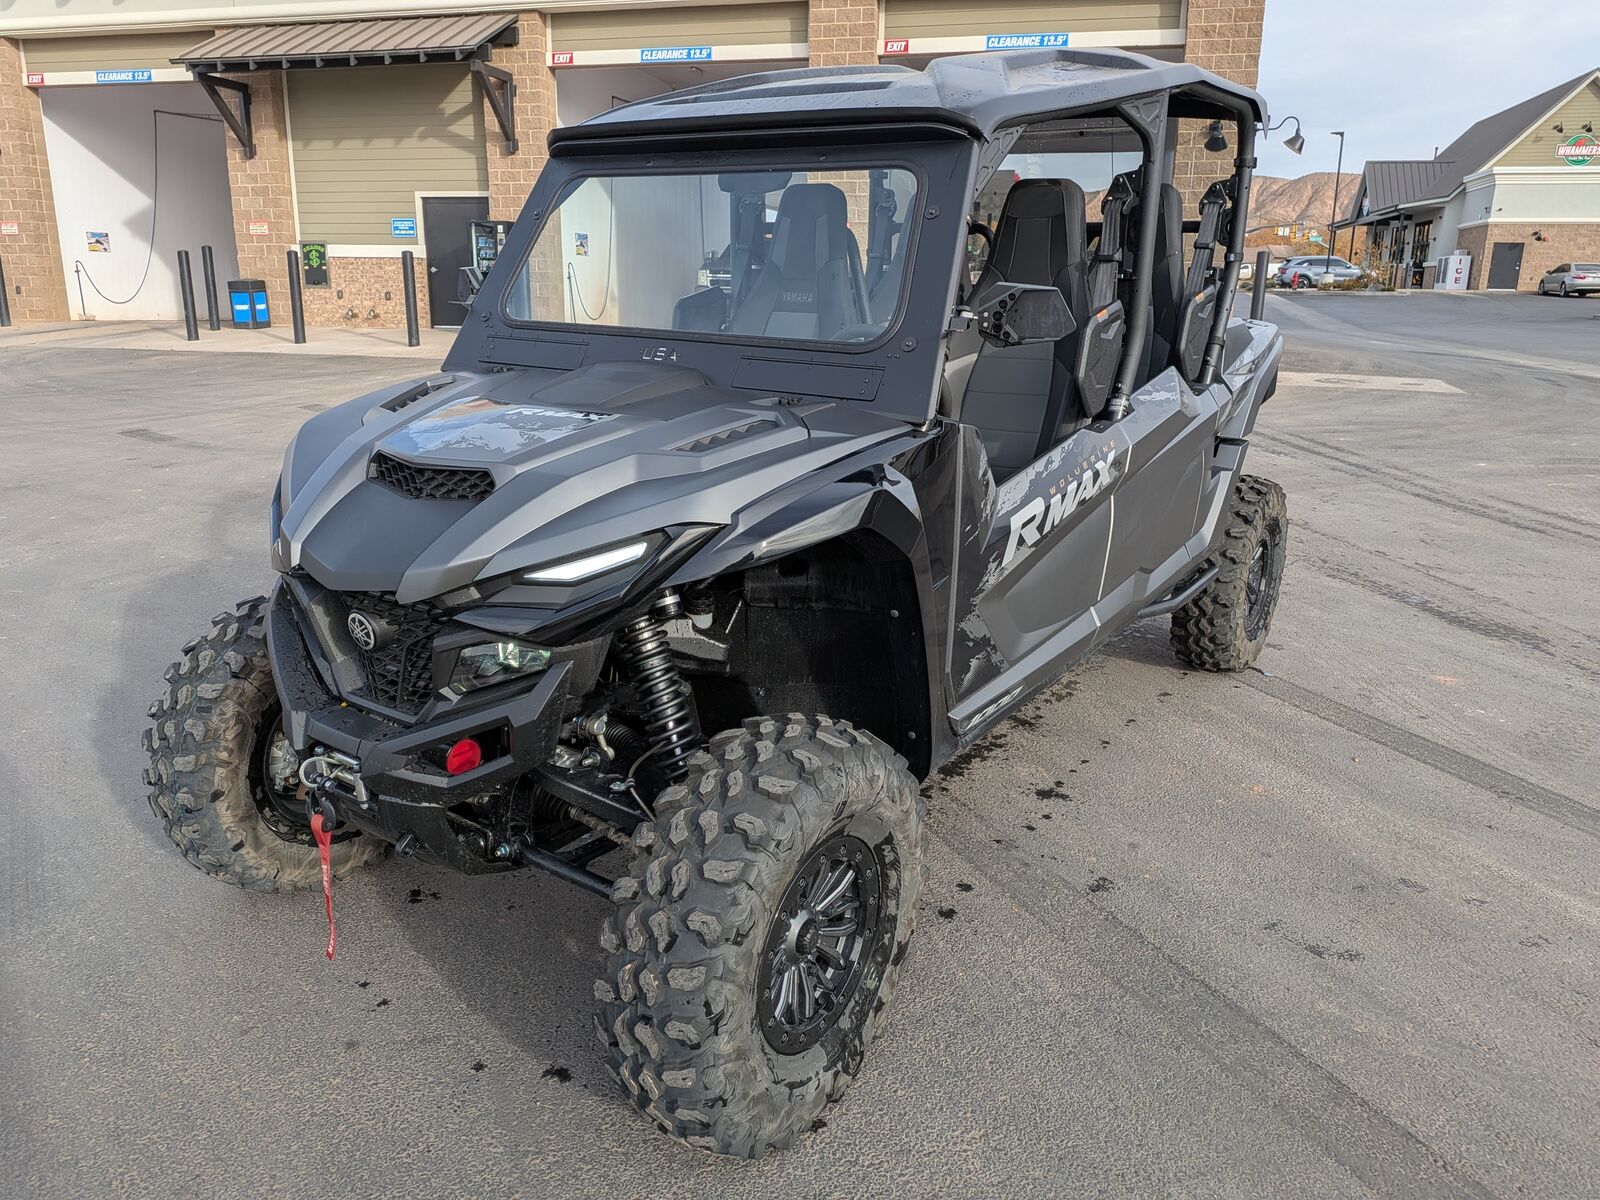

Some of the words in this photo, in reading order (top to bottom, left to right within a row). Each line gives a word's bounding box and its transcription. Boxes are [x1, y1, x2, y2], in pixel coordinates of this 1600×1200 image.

[887, 41, 906, 51] EXIT
[988, 36, 1040, 47] CLEARANCE
[1043, 35, 1066, 45] 13.5'
[554, 54, 571, 63] EXIT
[642, 50, 687, 60] CLEARANCE
[689, 48, 710, 58] 13.5'
[28, 75, 43, 83] EXIT
[97, 72, 133, 81] CLEARANCE
[134, 71, 150, 80] 13.5'
[1454, 258, 1463, 284] ICE
[1001, 449, 1116, 567] RMAX
